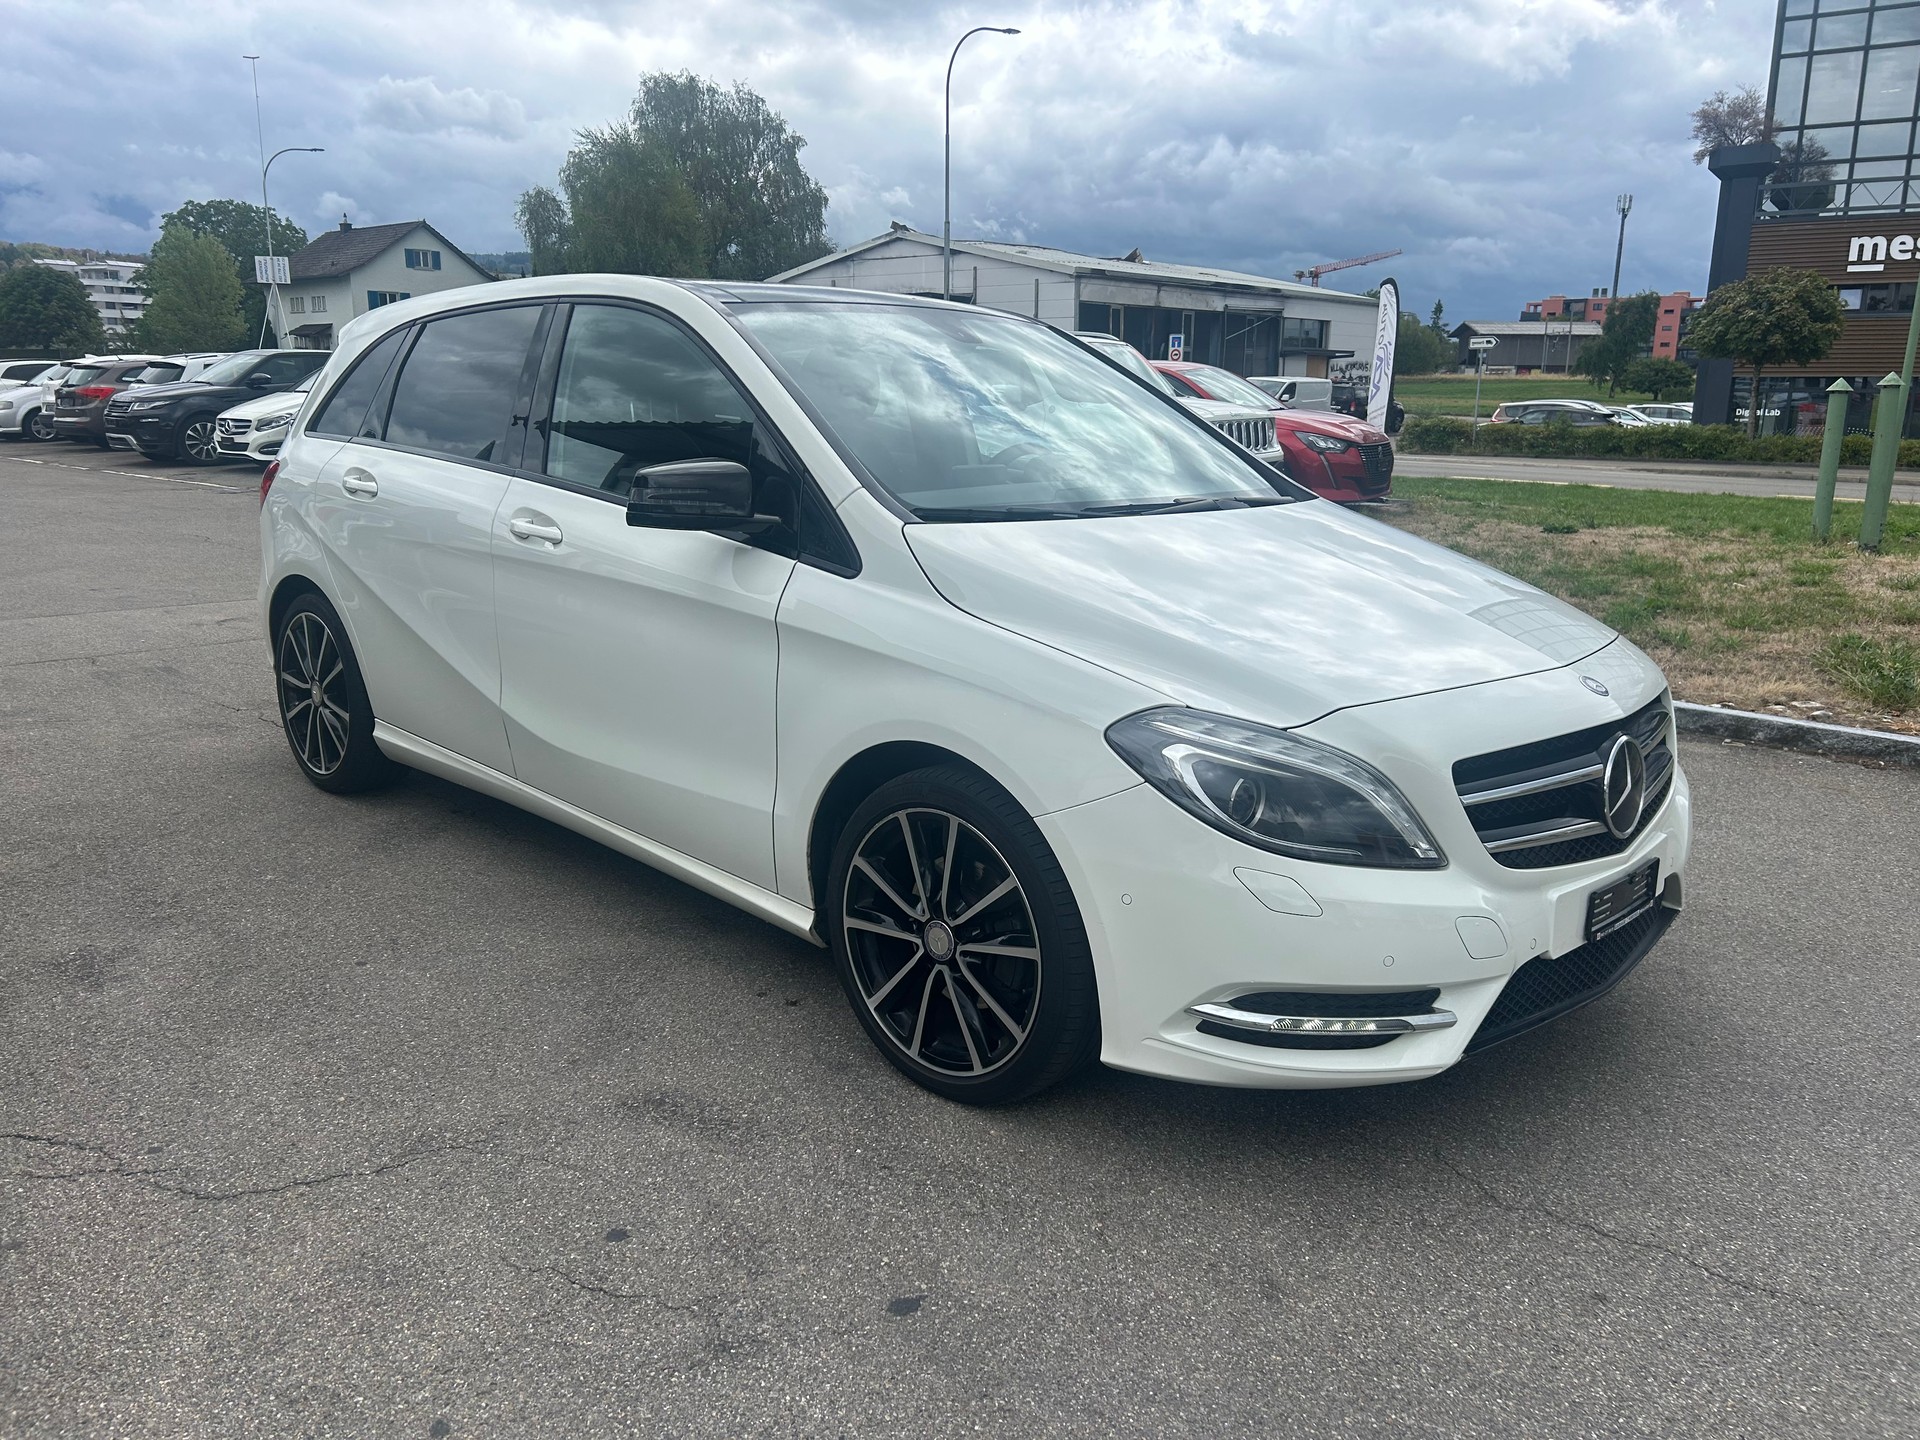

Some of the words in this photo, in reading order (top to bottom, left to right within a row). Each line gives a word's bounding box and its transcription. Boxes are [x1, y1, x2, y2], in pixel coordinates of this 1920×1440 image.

[1848, 234, 1920, 262] me
[1378, 303, 1388, 346] AUTO
[1735, 408, 1763, 417] Digal
[1764, 408, 1781, 417] Lab
